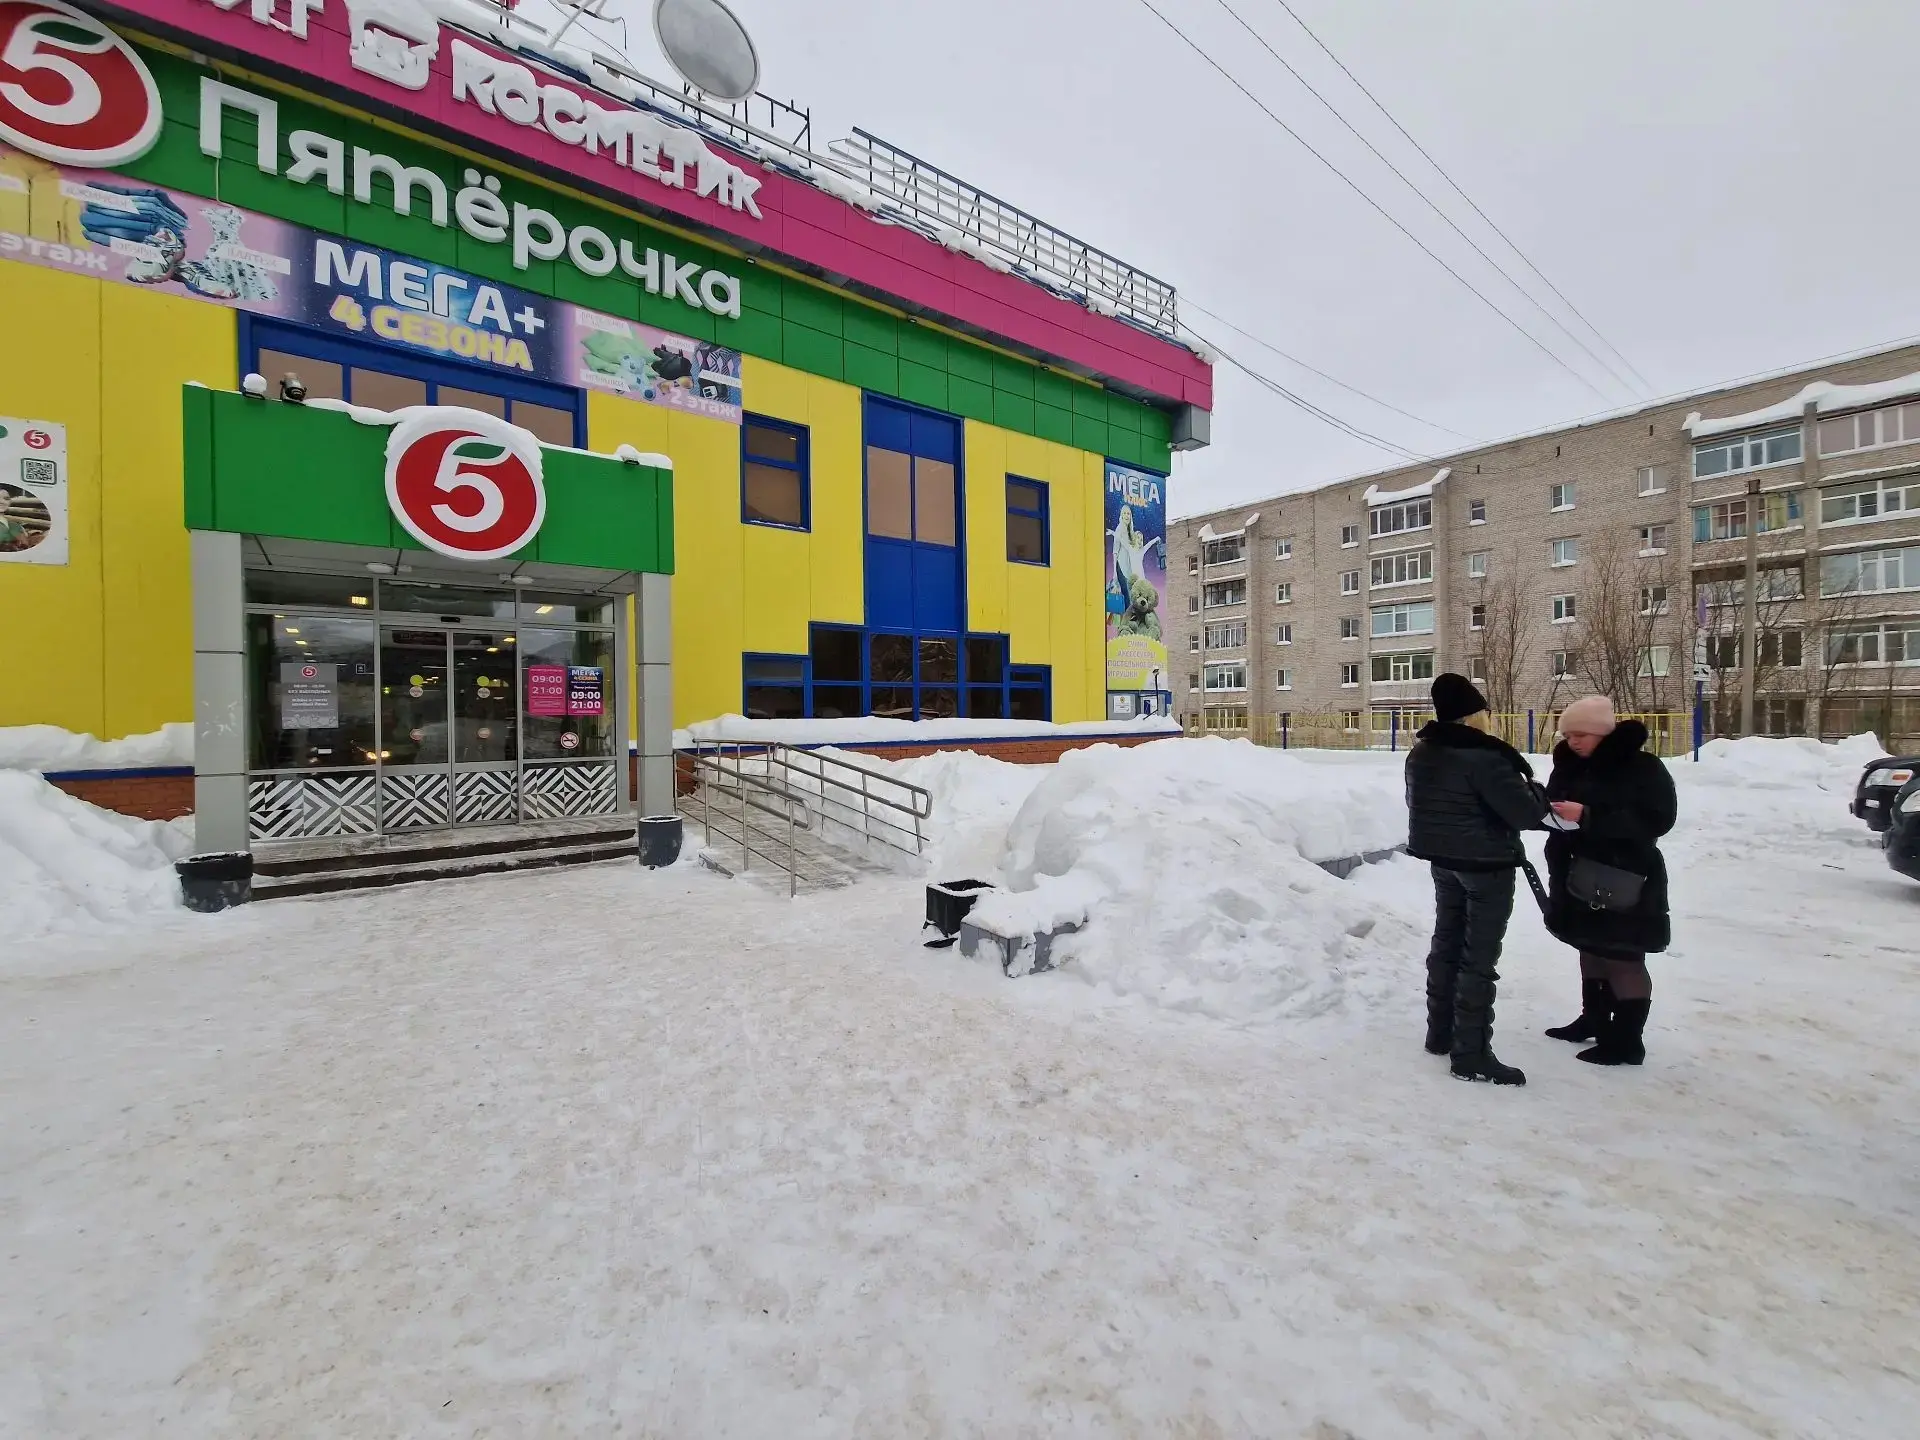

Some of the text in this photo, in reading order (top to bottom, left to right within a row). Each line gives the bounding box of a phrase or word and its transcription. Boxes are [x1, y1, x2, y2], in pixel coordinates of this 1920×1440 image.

[200, 76, 742, 320] Пятёрочка
[314, 238, 545, 335] МЕГА+
[329, 294, 534, 372] 4 СЕЗОНА
[669, 387, 737, 418] 2 этаж
[430, 436, 511, 533] 5
[1109, 471, 1161, 505] МЕГА
[531, 675, 562, 683] 09:00
[532, 686, 563, 694] 21:00
[571, 691, 601, 699] 09:00
[571, 701, 601, 709] 21:00
